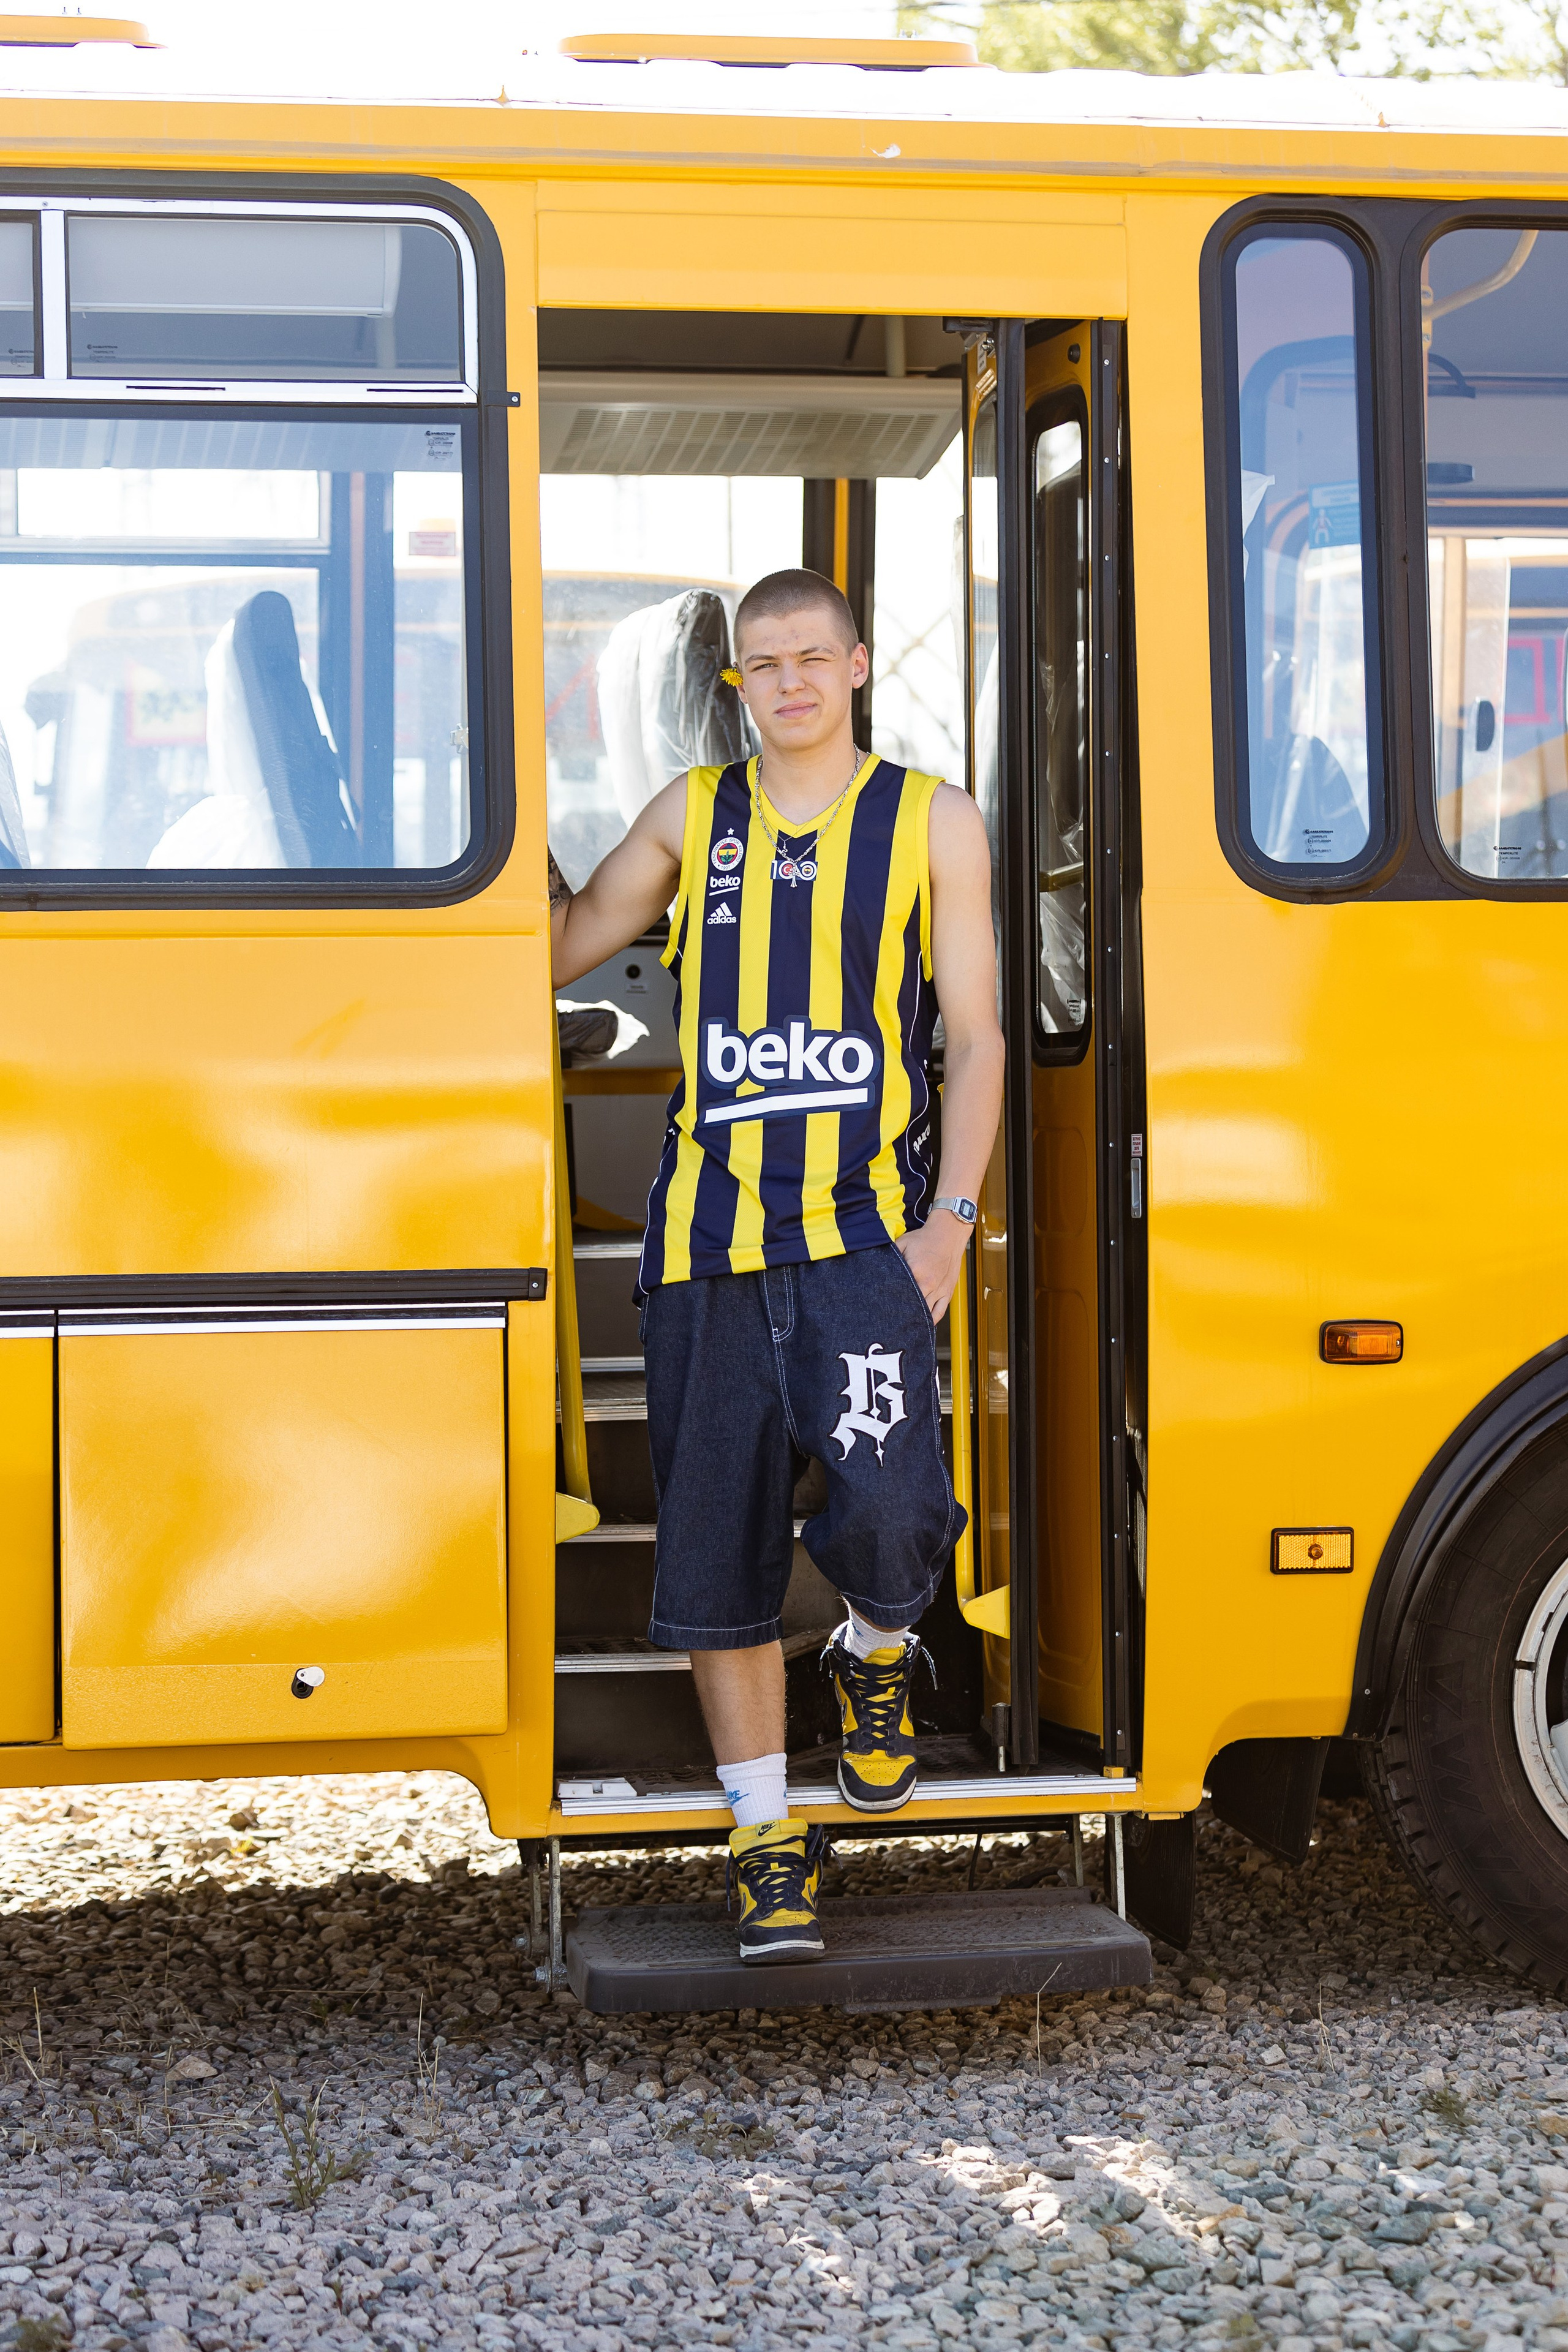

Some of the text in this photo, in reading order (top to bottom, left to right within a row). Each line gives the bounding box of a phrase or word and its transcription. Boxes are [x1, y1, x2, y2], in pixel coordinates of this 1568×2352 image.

[710, 875, 741, 888] beko
[707, 916, 737, 924] adidas
[707, 1022, 874, 1084] beko
[760, 1823, 773, 1831] NIKE
